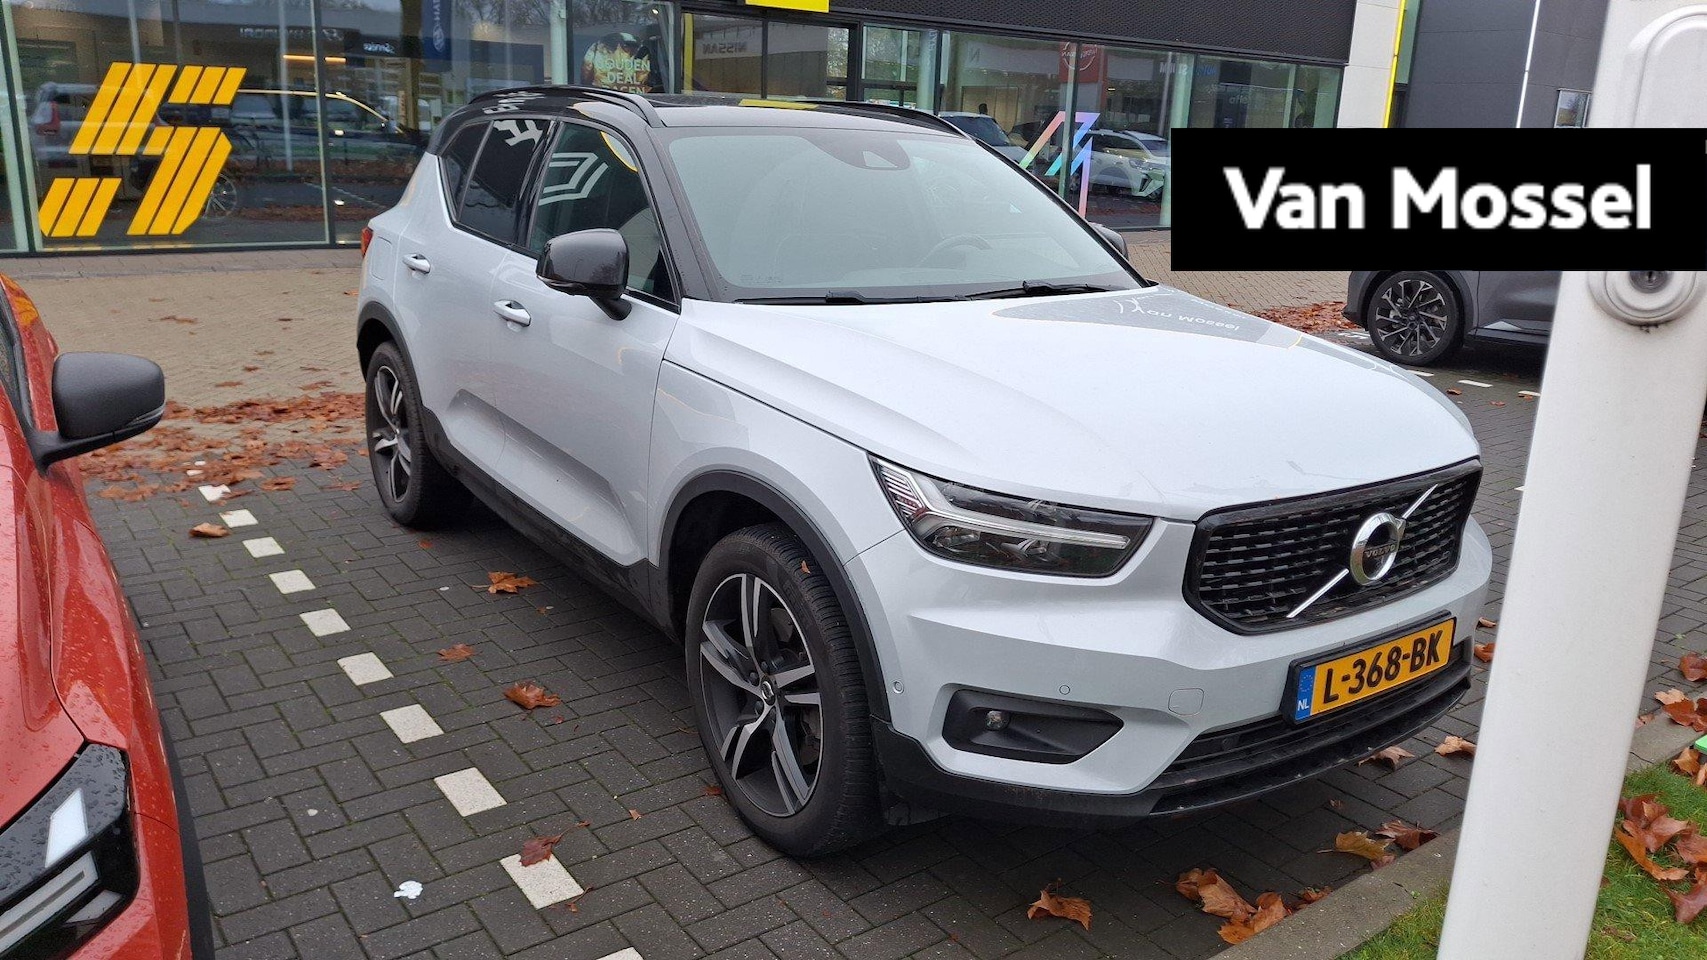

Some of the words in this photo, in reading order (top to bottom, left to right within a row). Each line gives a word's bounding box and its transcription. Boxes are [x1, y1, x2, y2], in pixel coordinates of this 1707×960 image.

[607, 71, 641, 85] DEAL
[1323, 629, 1444, 704] L-368-BK
[1297, 698, 1310, 711] NL
